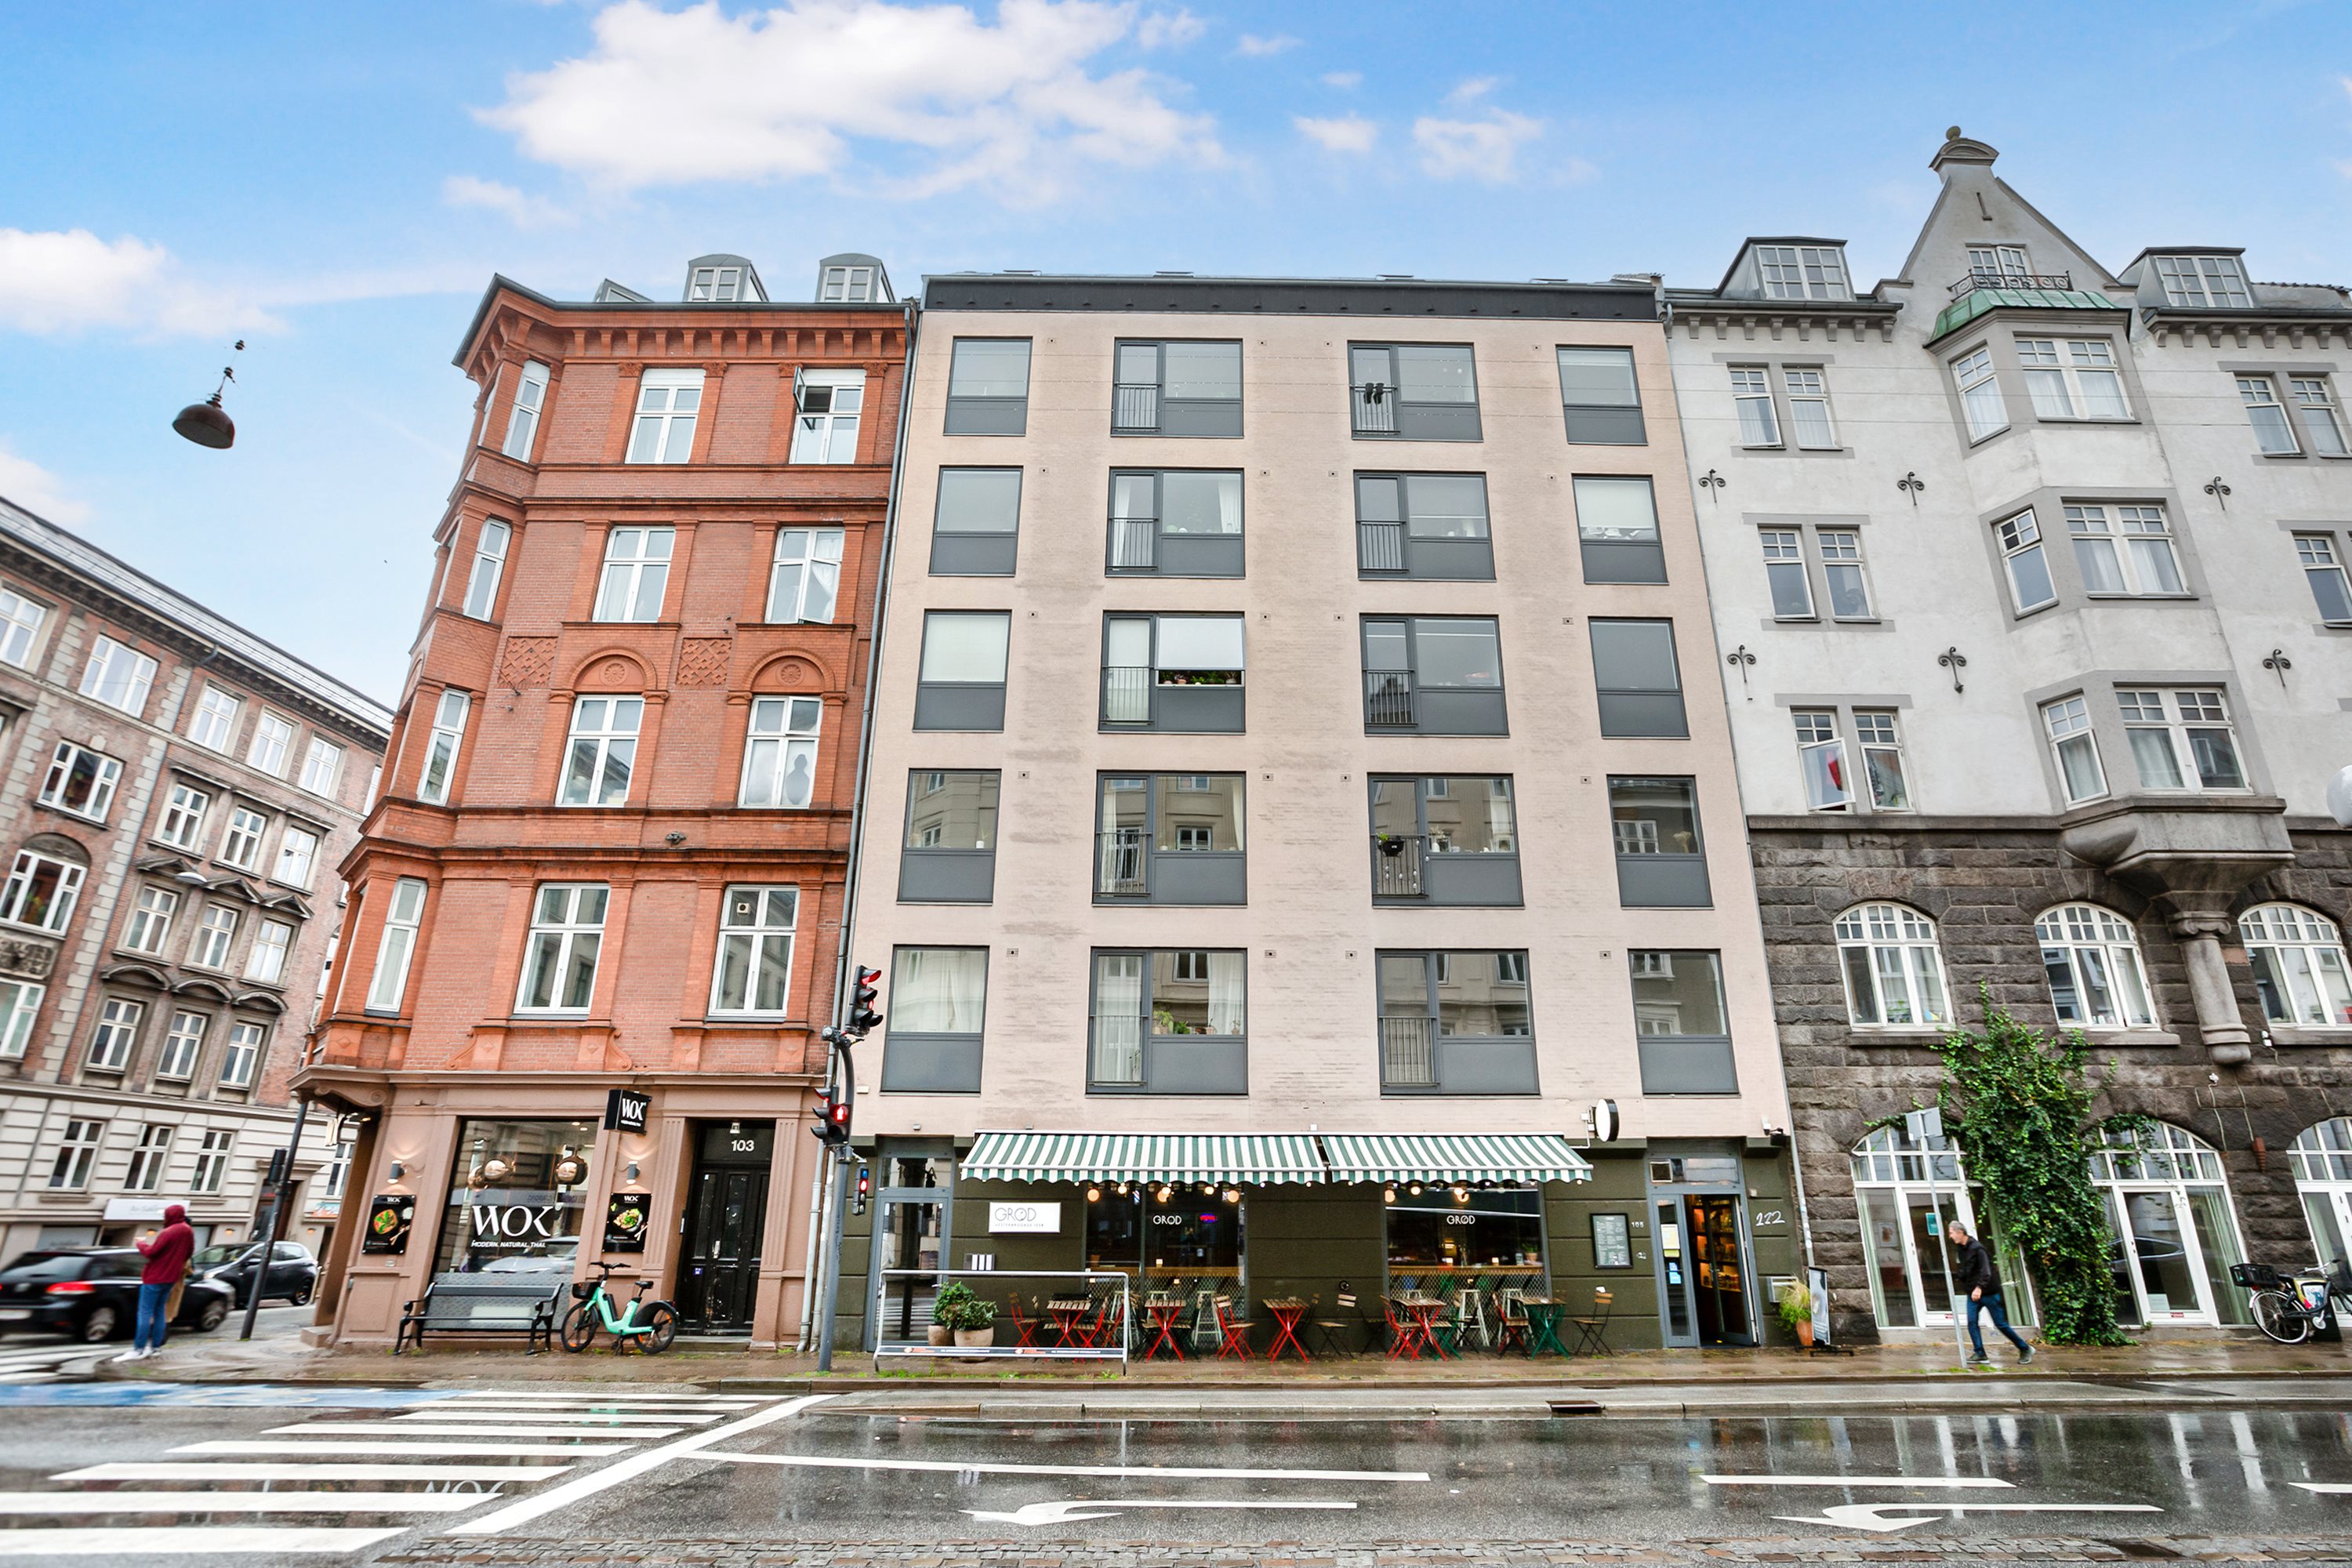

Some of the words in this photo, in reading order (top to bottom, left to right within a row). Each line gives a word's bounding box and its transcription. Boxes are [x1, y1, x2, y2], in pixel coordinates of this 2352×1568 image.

[622, 1098, 644, 1121] WOK
[731, 1140, 754, 1151] 103
[472, 1206, 553, 1236] WOK
